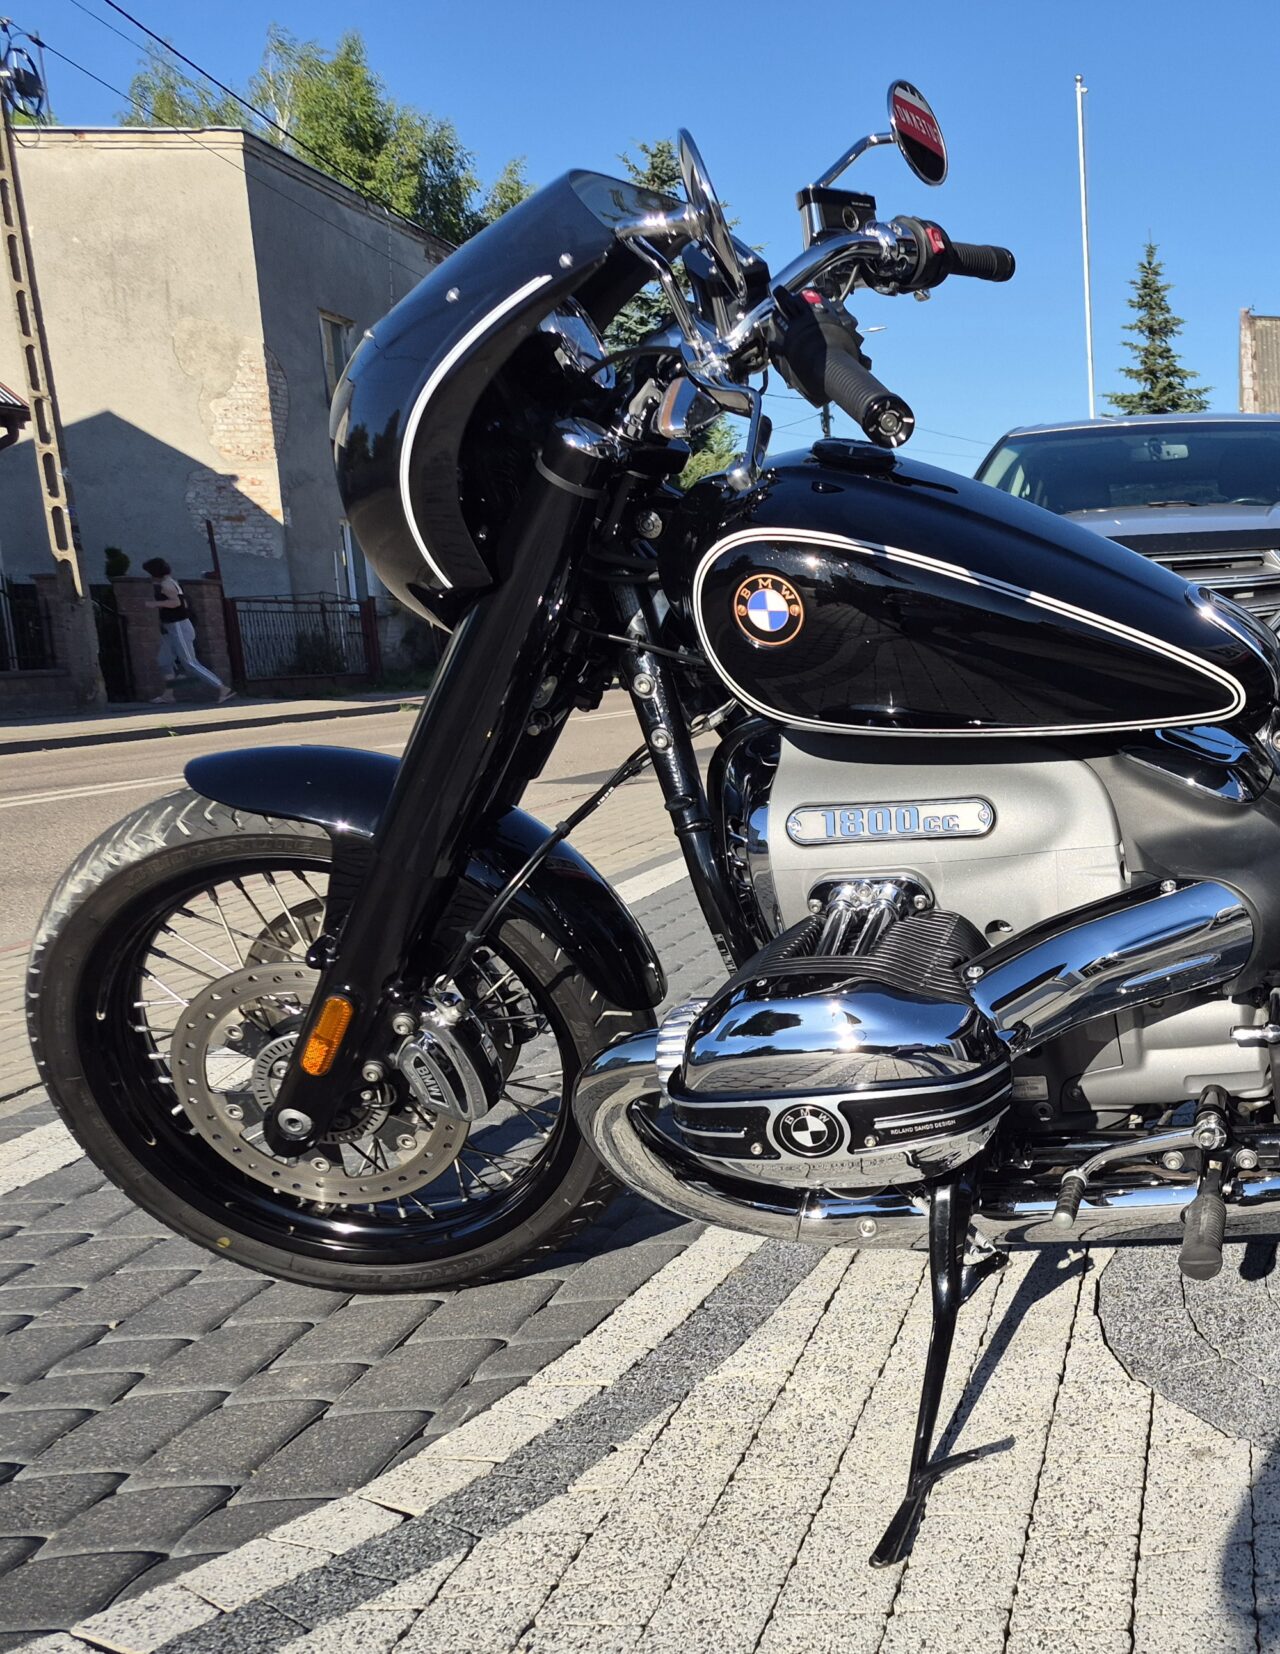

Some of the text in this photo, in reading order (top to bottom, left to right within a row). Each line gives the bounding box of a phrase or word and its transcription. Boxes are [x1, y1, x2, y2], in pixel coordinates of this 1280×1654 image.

[739, 578, 796, 600] BMW
[821, 806, 960, 838] 1800cc
[416, 1065, 443, 1098] BMW
[784, 1107, 830, 1126] BMW
[890, 1119, 957, 1136] ROLAND SANDS DESIGN
